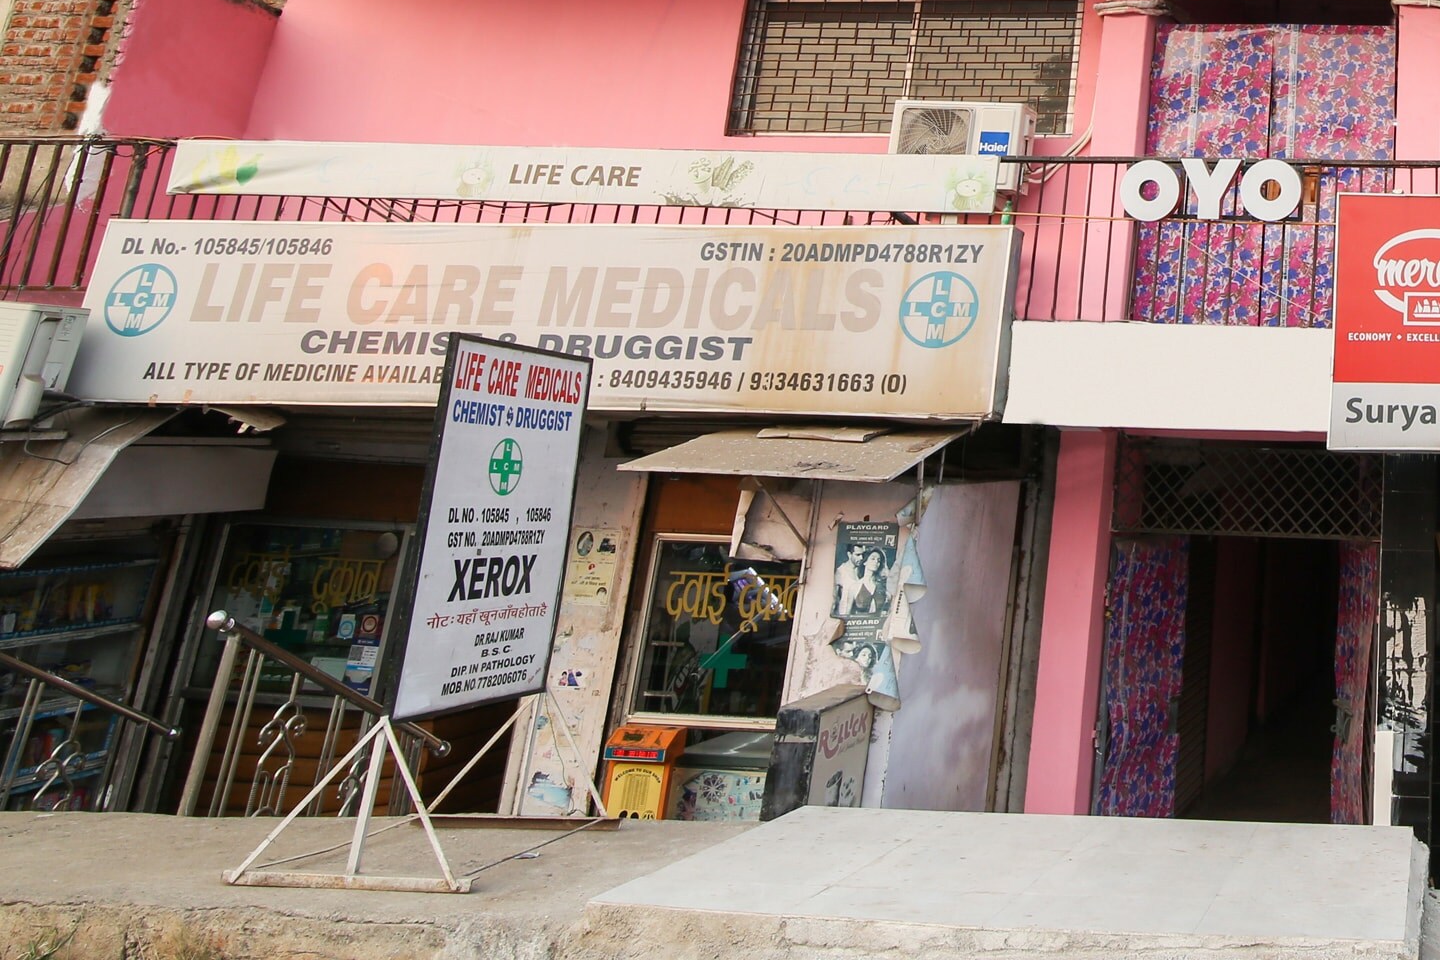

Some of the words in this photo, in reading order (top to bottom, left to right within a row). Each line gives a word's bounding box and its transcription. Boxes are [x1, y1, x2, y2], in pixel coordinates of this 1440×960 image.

[979, 142, 1008, 152] Haier
[509, 164, 564, 185] LIFE
[571, 165, 642, 187] CARE
[1120, 158, 1301, 221] OYO
[122, 237, 145, 255] DL
[193, 238, 333, 256] 105845/105846
[700, 243, 764, 262] GSTIN
[780, 243, 984, 264] 20ADMPD4788R1ZY
[189, 263, 333, 324] LIFE
[346, 262, 524, 328] CARE
[537, 266, 885, 333] MEDICALS
[299, 330, 482, 356] CHEMIS
[537, 333, 752, 361] DRUGGIST
[1348, 333, 1392, 342] ECONOMY
[143, 362, 176, 380] ALL
[184, 362, 230, 381] TYPE
[235, 363, 259, 381] OF
[264, 363, 357, 383] MEDICINE
[609, 371, 732, 390] 8409435946
[455, 351, 486, 392] LIFE
[488, 358, 522, 397] CARE
[524, 365, 582, 405] MEDICALS
[452, 399, 505, 427] CHEMIST
[515, 406, 573, 431] DRUGGIST
[1345, 397, 1437, 431] Surya
[448, 508, 459, 523] DL
[481, 508, 510, 523] 105845
[526, 507, 551, 522] 105846
[448, 531, 464, 548] GST
[447, 554, 537, 602] XEROX
[666, 563, 735, 625] दवाई
[499, 627, 525, 643] KUMAR
[469, 663, 479, 674] IN
[481, 654, 536, 672] PATHOLOGY
